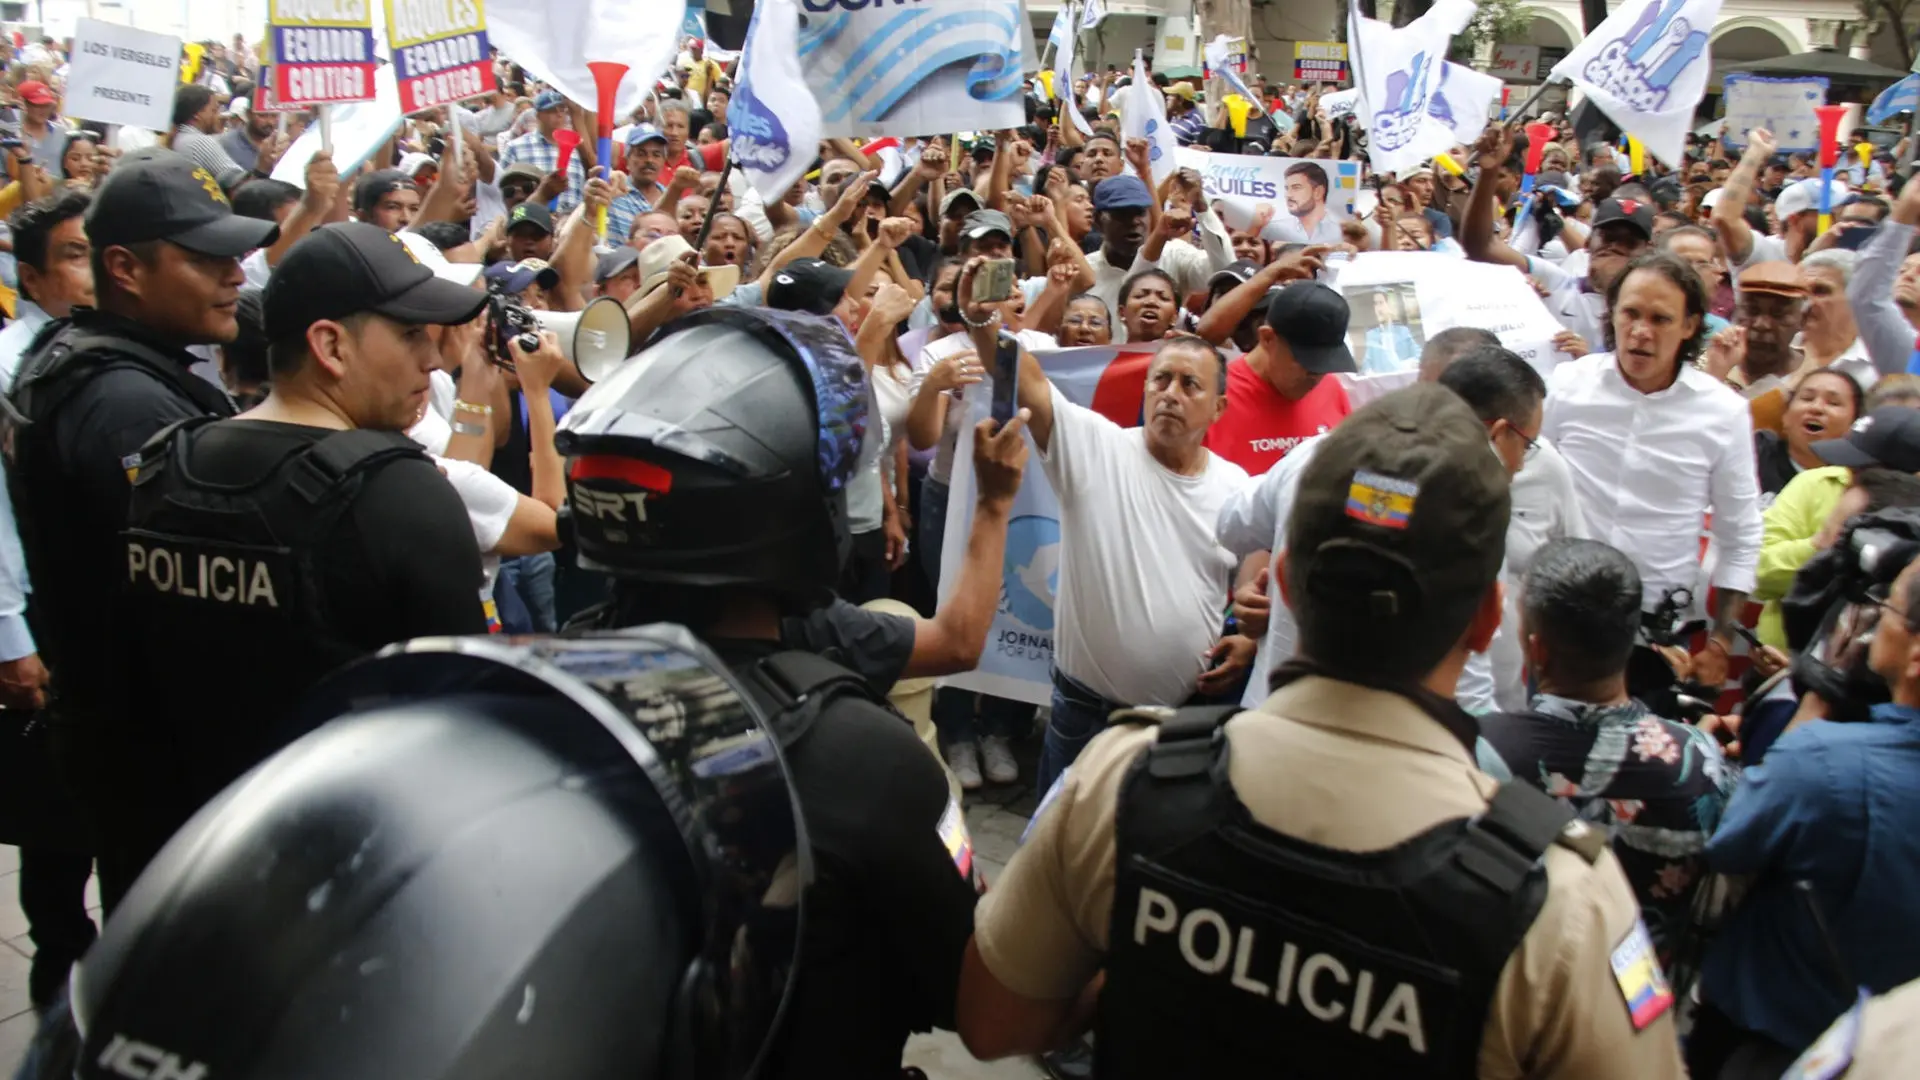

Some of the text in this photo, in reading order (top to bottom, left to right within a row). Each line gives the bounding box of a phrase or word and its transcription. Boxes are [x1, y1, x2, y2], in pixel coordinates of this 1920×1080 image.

[83, 40, 172, 68] LOS VERGELES
[282, 28, 365, 62] ECUADOR
[402, 34, 480, 77] ECUADOR
[93, 86, 151, 106] PRESENTE
[288, 66, 365, 100] CONTIGO
[411, 66, 482, 108] CONTIGO
[1249, 436, 1299, 453] TOMMY
[128, 543, 279, 607] POLICIA
[1134, 886, 1428, 1054] POLICIA
